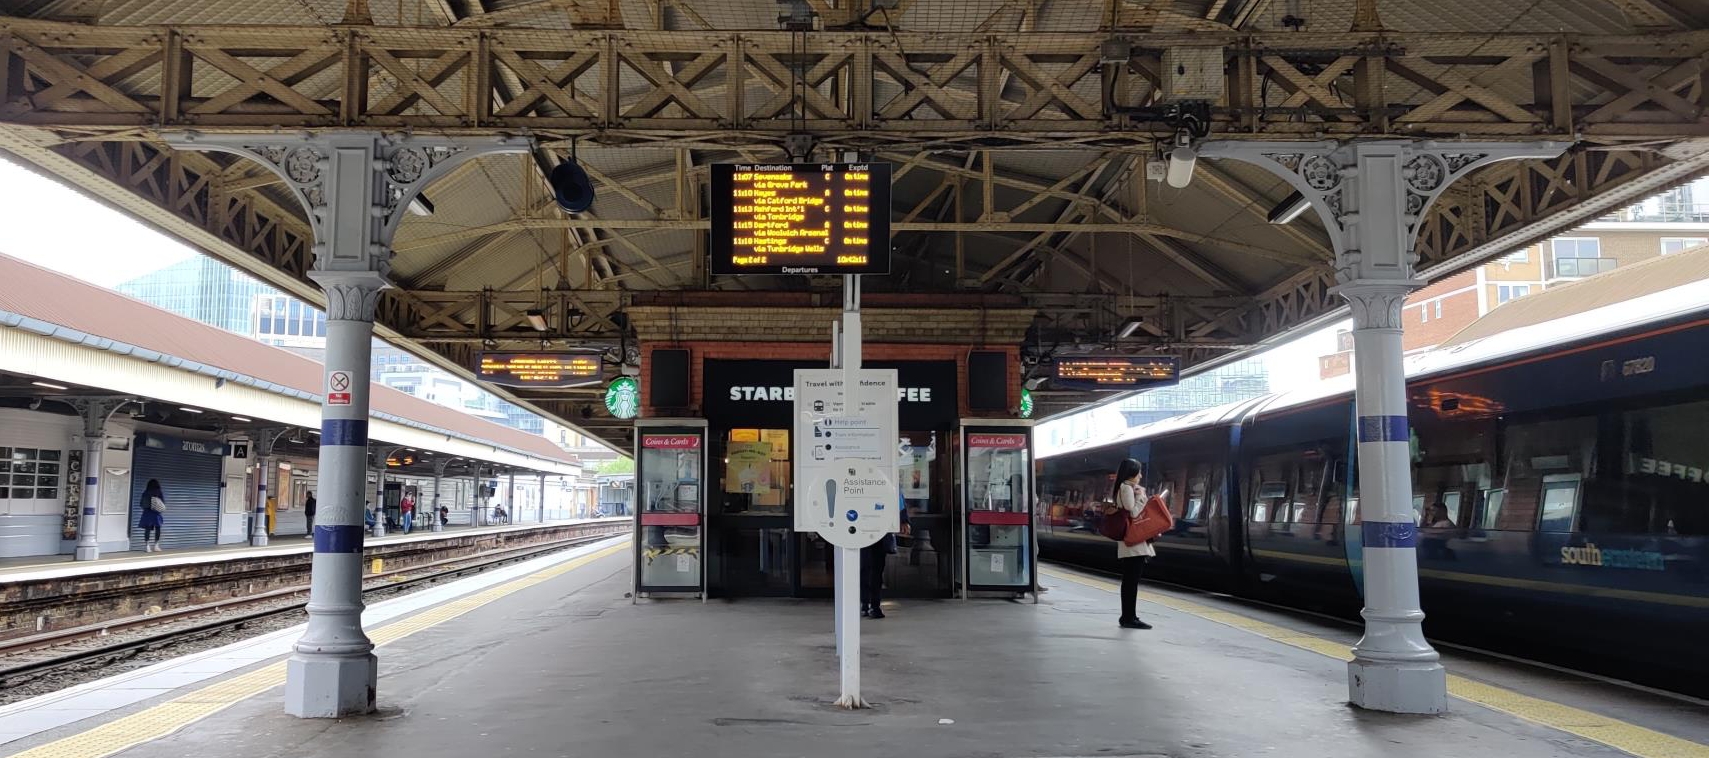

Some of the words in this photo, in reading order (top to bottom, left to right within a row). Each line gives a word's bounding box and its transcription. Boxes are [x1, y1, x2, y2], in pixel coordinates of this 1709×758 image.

[734, 164, 752, 172] Time
[754, 164, 793, 172] Destination
[821, 164, 834, 172] Plat
[848, 164, 869, 172] Exptd
[733, 173, 753, 181] 11:07
[844, 173, 853, 181] On
[853, 173, 869, 181] time
[753, 181, 766, 189] via
[767, 181, 789, 189] Grove
[790, 181, 808, 189] Park
[754, 189, 777, 198] Hayes
[844, 189, 853, 197] On
[853, 189, 869, 197] time
[753, 197, 766, 205] via
[767, 197, 797, 205] Catford
[798, 197, 824, 206] Bridge
[754, 205, 784, 213] Ashford
[844, 205, 852, 213] On
[853, 205, 869, 213] time
[753, 213, 766, 221] via
[767, 213, 805, 222] Tonbridge
[754, 221, 789, 229] Dartford
[843, 221, 852, 229] On
[853, 221, 869, 229] time
[753, 229, 766, 237] via
[767, 229, 799, 237] Woolwich
[799, 229, 829, 237] Arsenal
[754, 237, 787, 246] Hastings
[843, 237, 852, 245] On
[853, 237, 868, 245] time
[753, 245, 766, 253] via
[767, 245, 804, 254] Tunbridge
[805, 245, 825, 253] Wells
[732, 256, 748, 265] Page
[753, 256, 761, 264] of
[782, 266, 818, 274] Departures
[730, 386, 795, 401] STARB
[898, 387, 931, 402] FEE
[645, 437, 663, 446] Coins
[670, 437, 689, 446] Cards
[995, 437, 1015, 445] Cards
[236, 446, 245, 457] A
[843, 478, 887, 486] Assistance
[67, 461, 80, 527] COFFEE
[843, 486, 864, 494] Point
